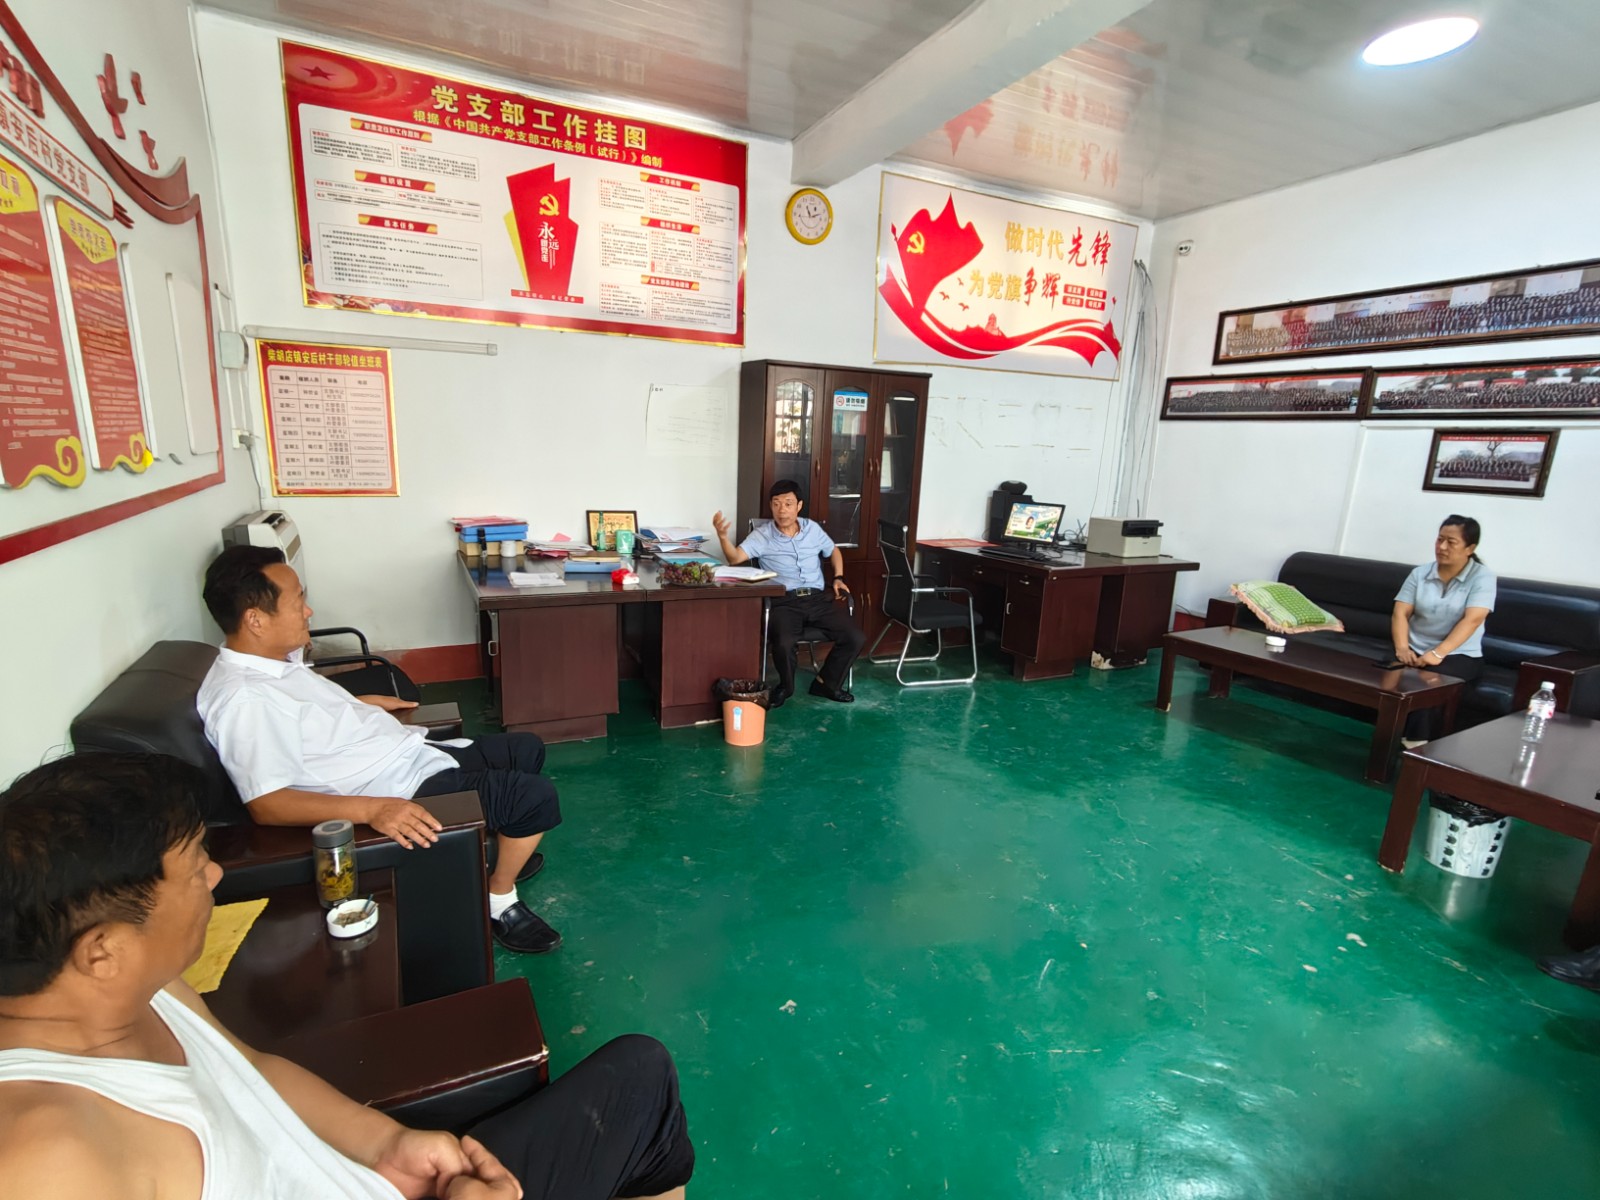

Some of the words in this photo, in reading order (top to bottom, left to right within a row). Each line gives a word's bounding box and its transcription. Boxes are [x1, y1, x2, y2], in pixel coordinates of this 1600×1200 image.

[431, 85, 646, 151] 党支部工作挂图
[1004, 221, 1111, 276] 做时代先锋
[969, 266, 1062, 310] 为党旗争辉
